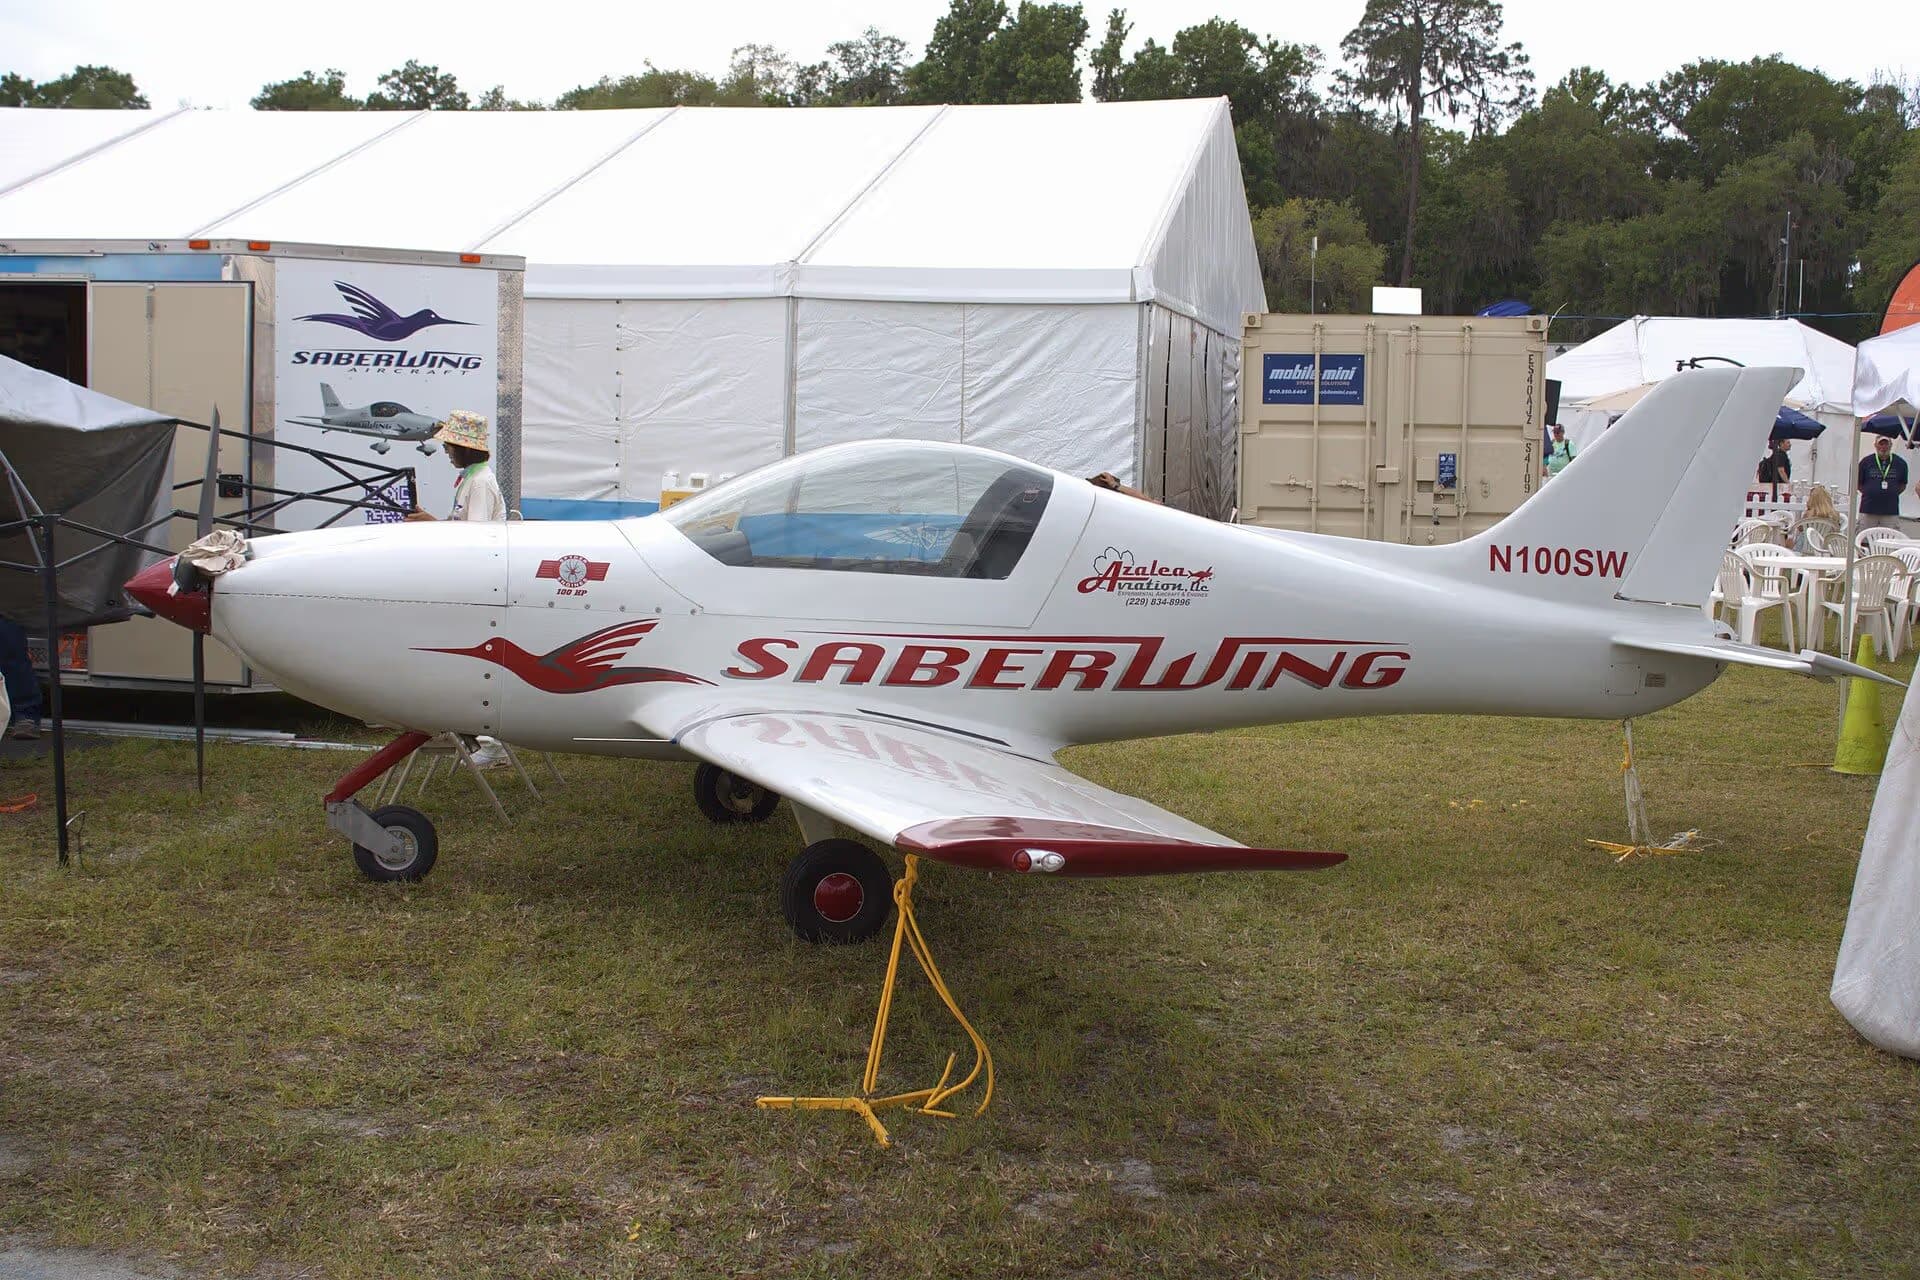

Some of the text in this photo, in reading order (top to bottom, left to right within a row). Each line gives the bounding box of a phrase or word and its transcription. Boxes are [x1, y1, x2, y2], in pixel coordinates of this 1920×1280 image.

[291, 348, 482, 370] SABERWING
[348, 367, 471, 376] AIRCRAFT
[1321, 366, 1358, 380] mini
[1489, 544, 1629, 578] N100SW
[1077, 559, 1188, 593] Azalea
[556, 588, 588, 597] 100 HP
[1125, 597, 1149, 607] (229)
[727, 632, 1411, 691] SABERWING
